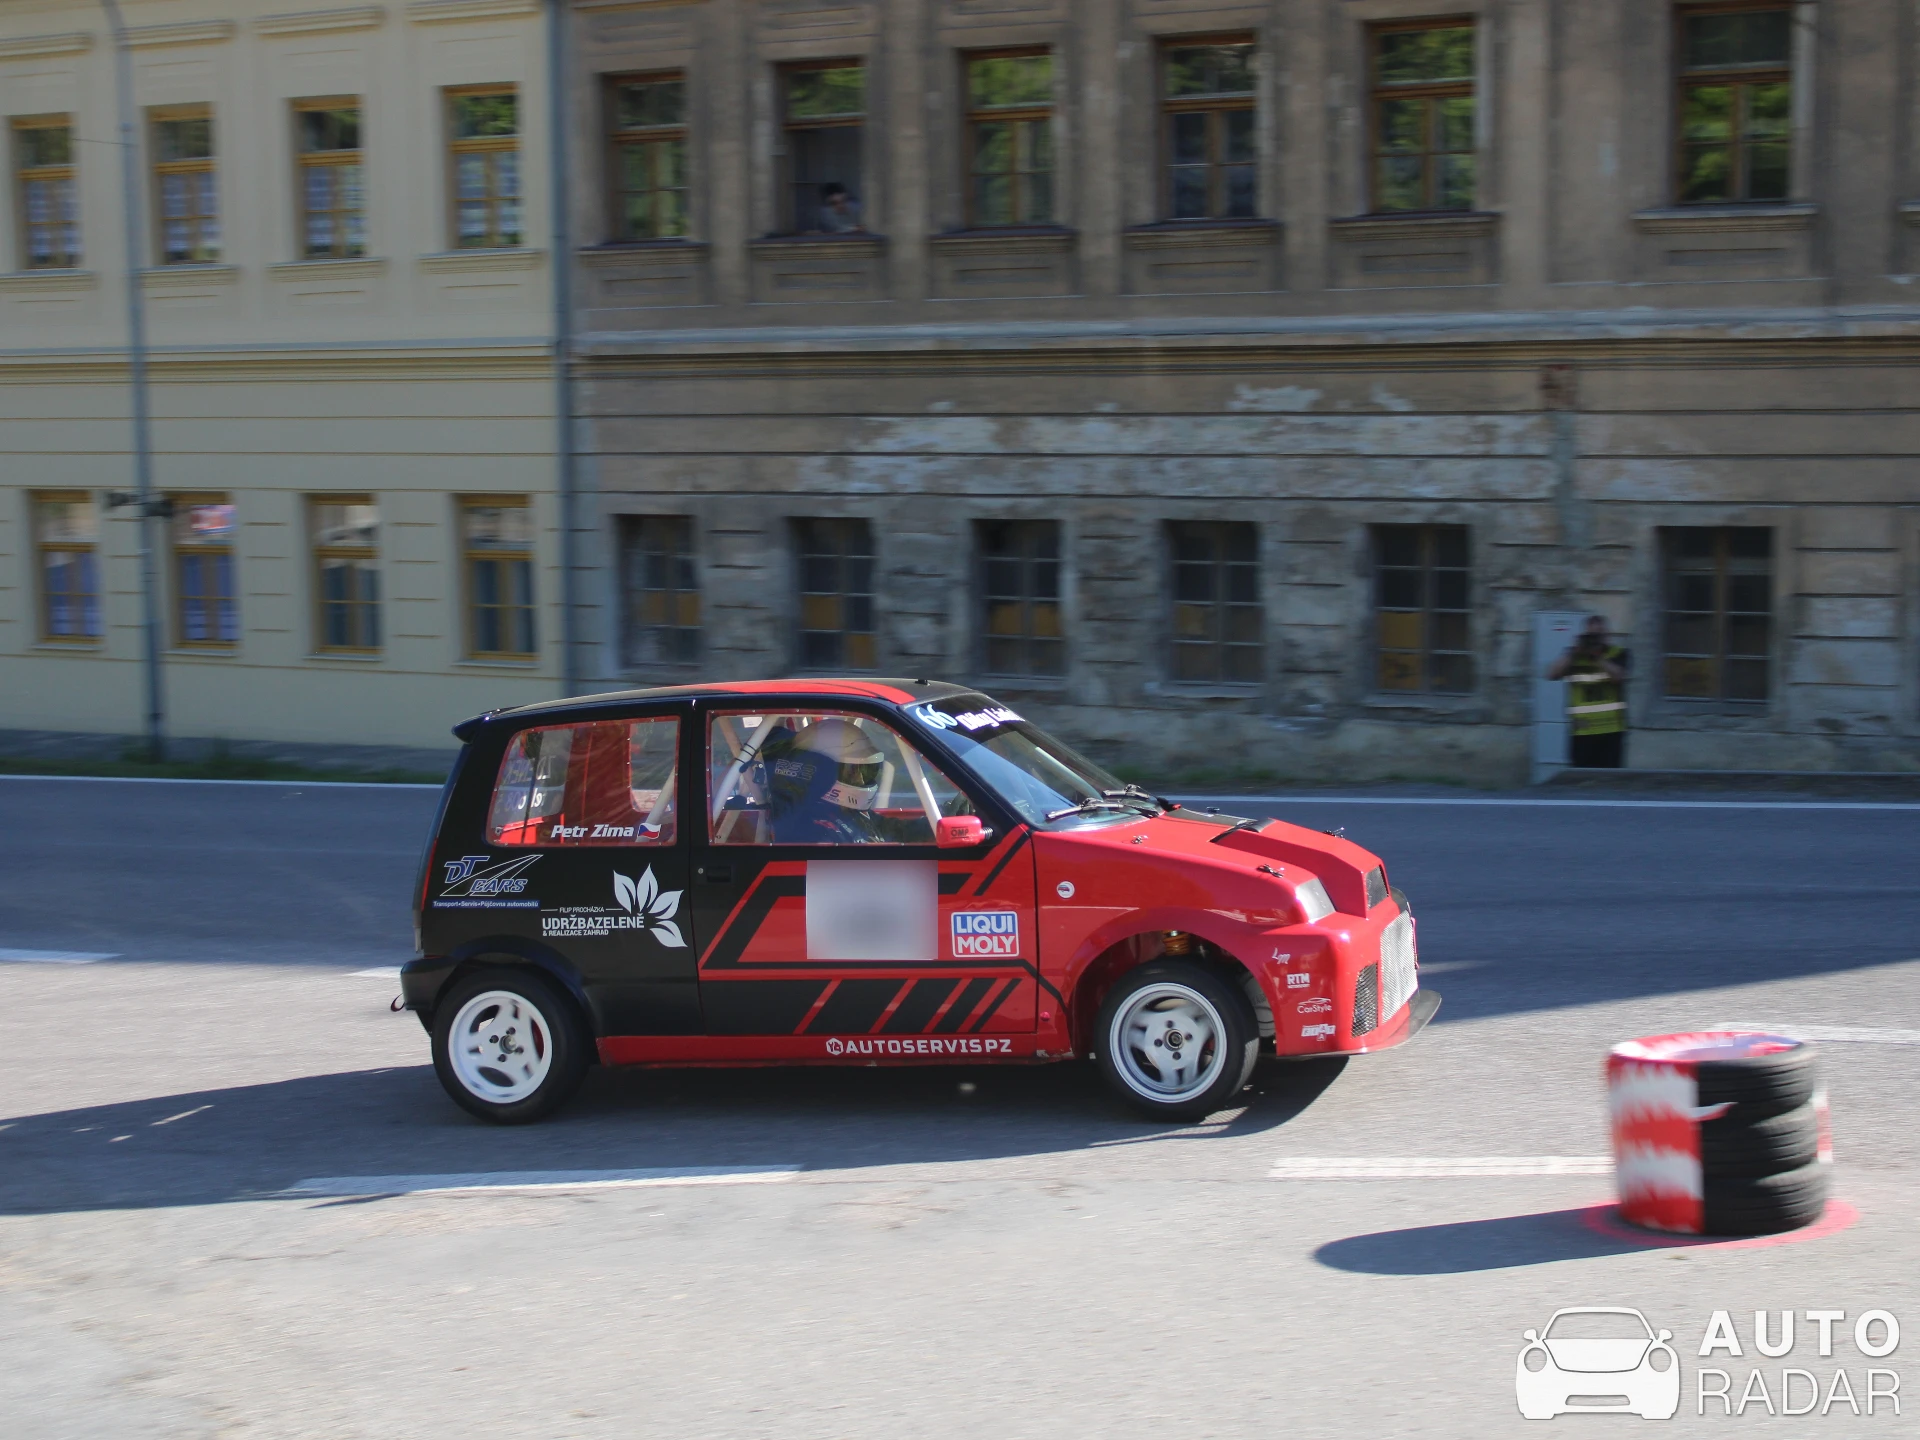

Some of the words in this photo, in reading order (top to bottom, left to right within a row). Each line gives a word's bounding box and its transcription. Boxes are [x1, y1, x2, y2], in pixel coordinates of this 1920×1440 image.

[915, 704, 958, 729] 66
[551, 825, 588, 838] Petr
[590, 824, 634, 838] Zima
[444, 856, 490, 883] DT
[470, 879, 528, 892] CARS
[542, 912, 645, 930] UDRŽBAZELENĚ
[956, 915, 1014, 934] LIQUI
[548, 929, 582, 937] REALIZACE
[957, 935, 1015, 954] MOLY
[1287, 972, 1310, 985] RTM
[1297, 1004, 1332, 1014] CarStyle
